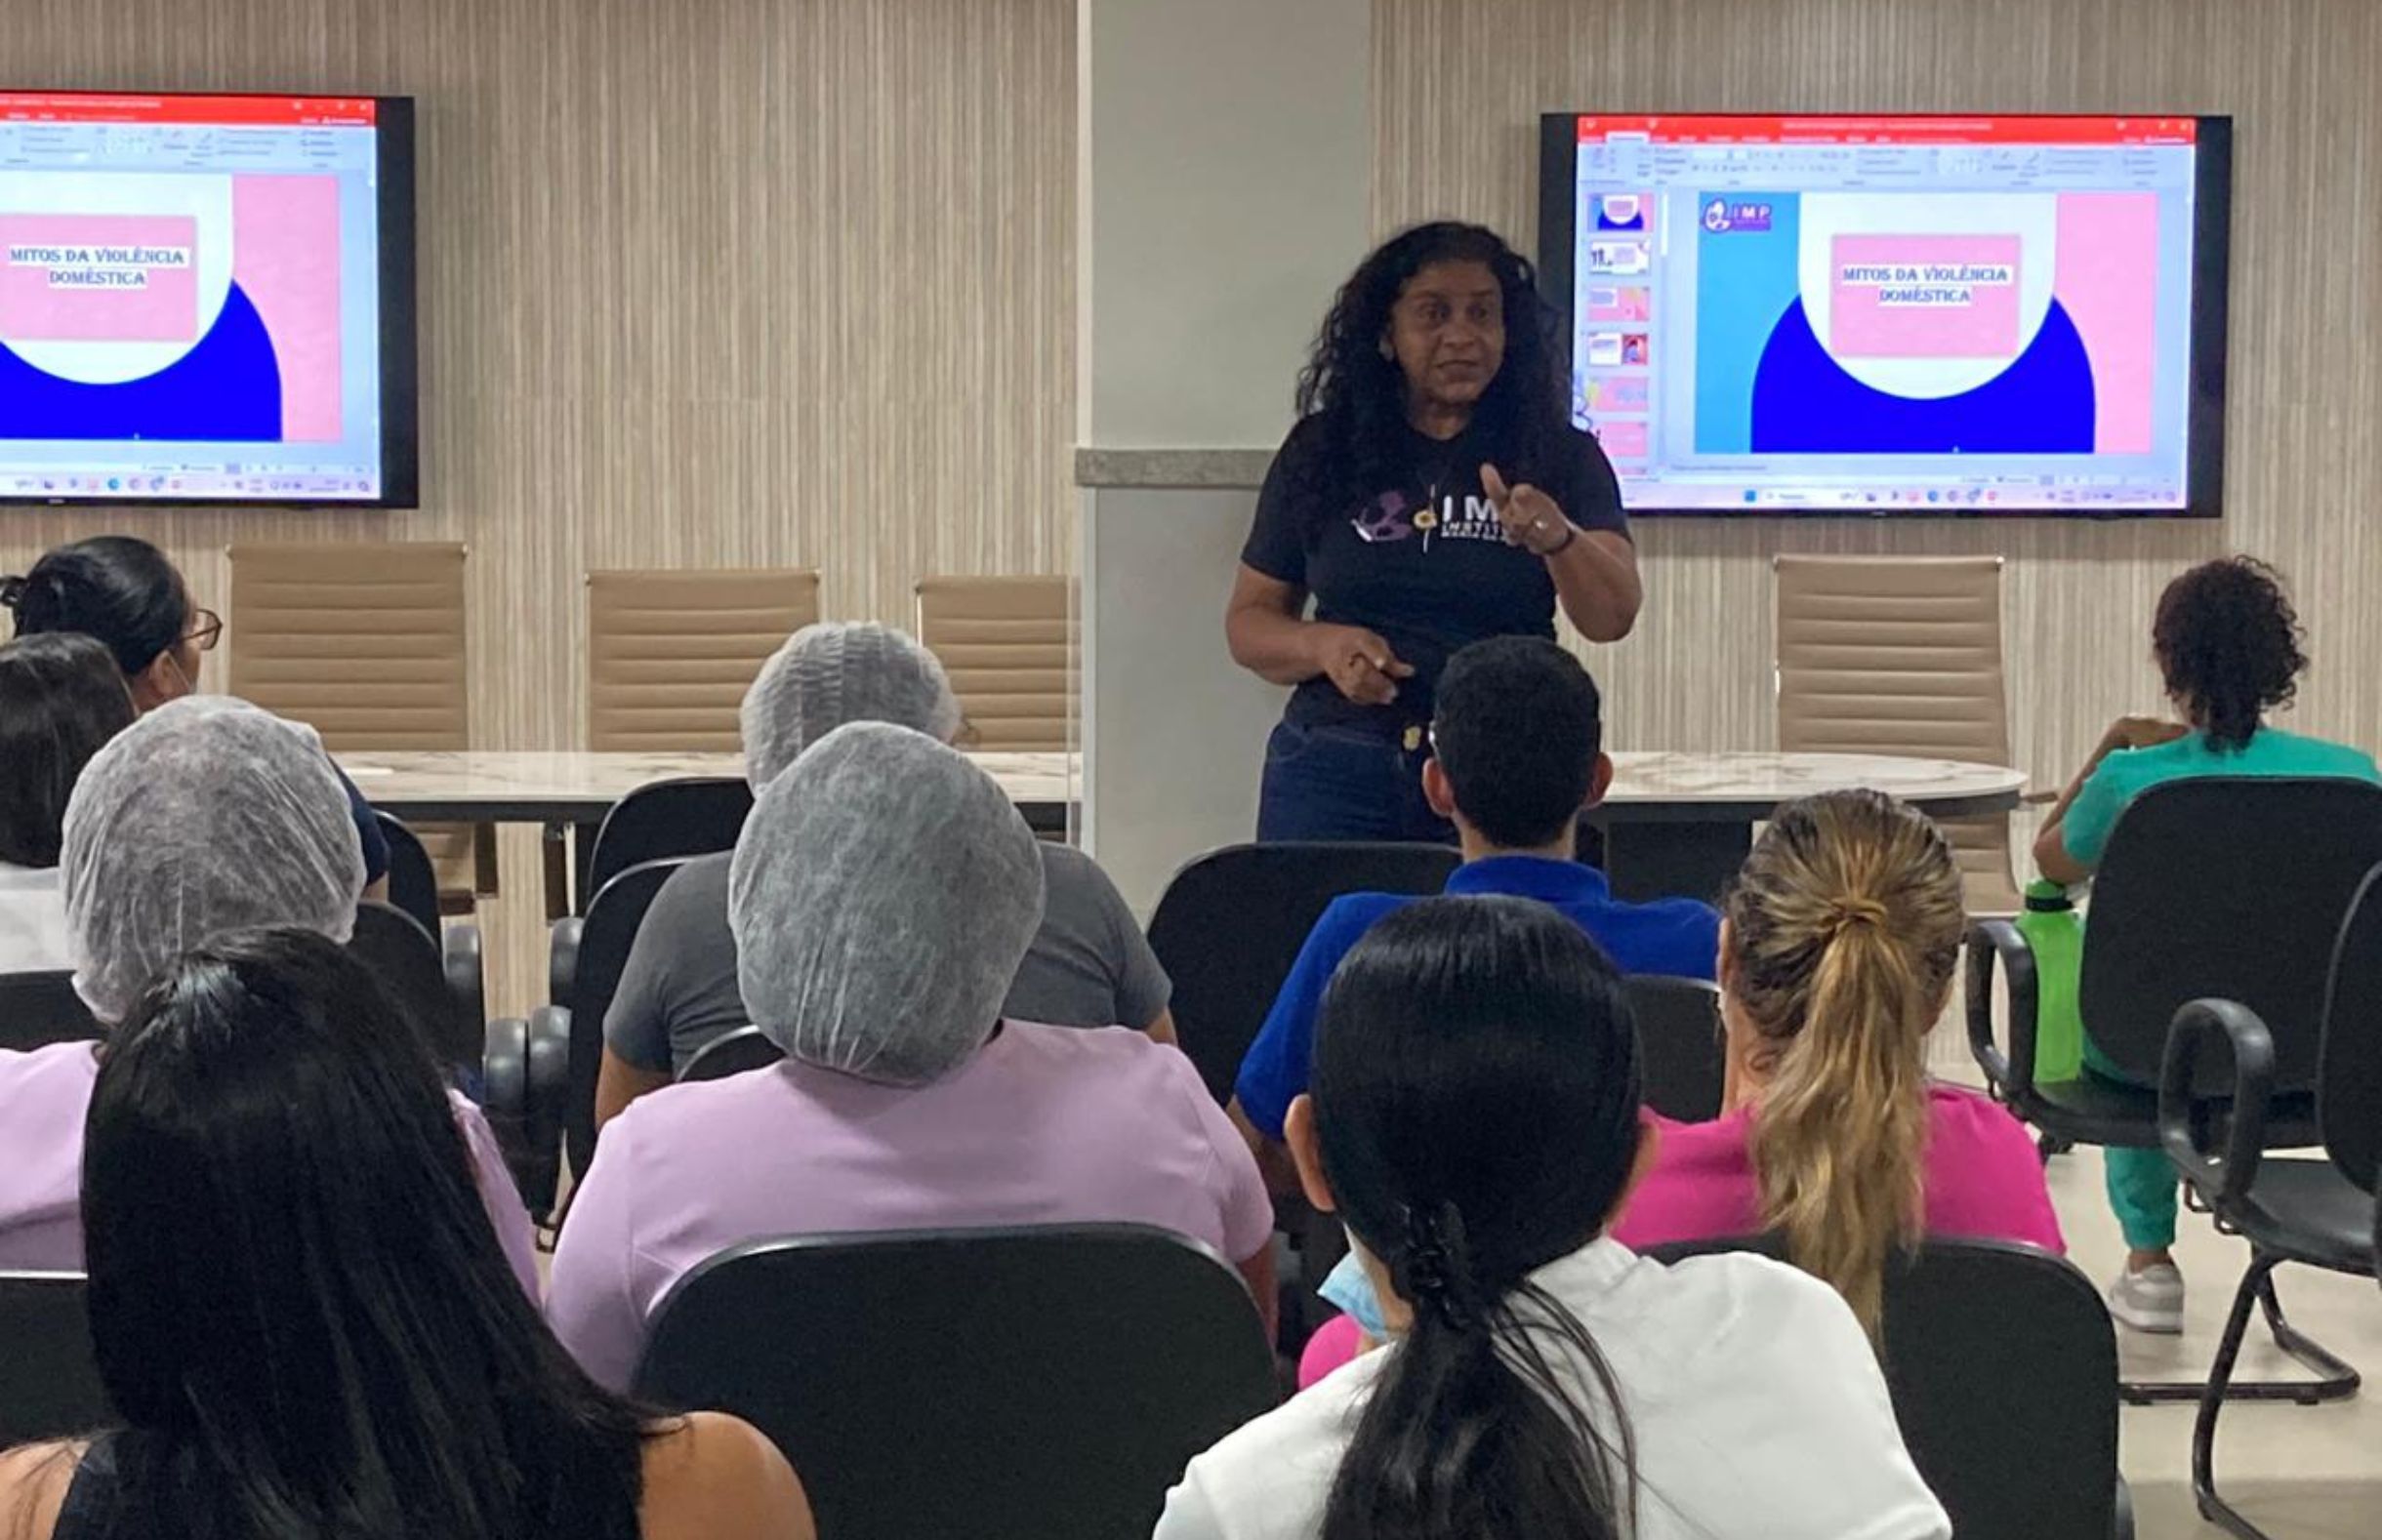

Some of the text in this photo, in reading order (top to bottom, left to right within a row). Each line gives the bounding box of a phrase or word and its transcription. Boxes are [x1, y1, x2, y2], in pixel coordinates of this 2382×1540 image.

[1732, 203, 1772, 220] IMP
[10, 248, 62, 263] MITOS
[65, 249, 90, 263] DA
[1842, 267, 1892, 281] MITOS
[1895, 267, 1918, 282] DA
[1443, 495, 1499, 522] IM
